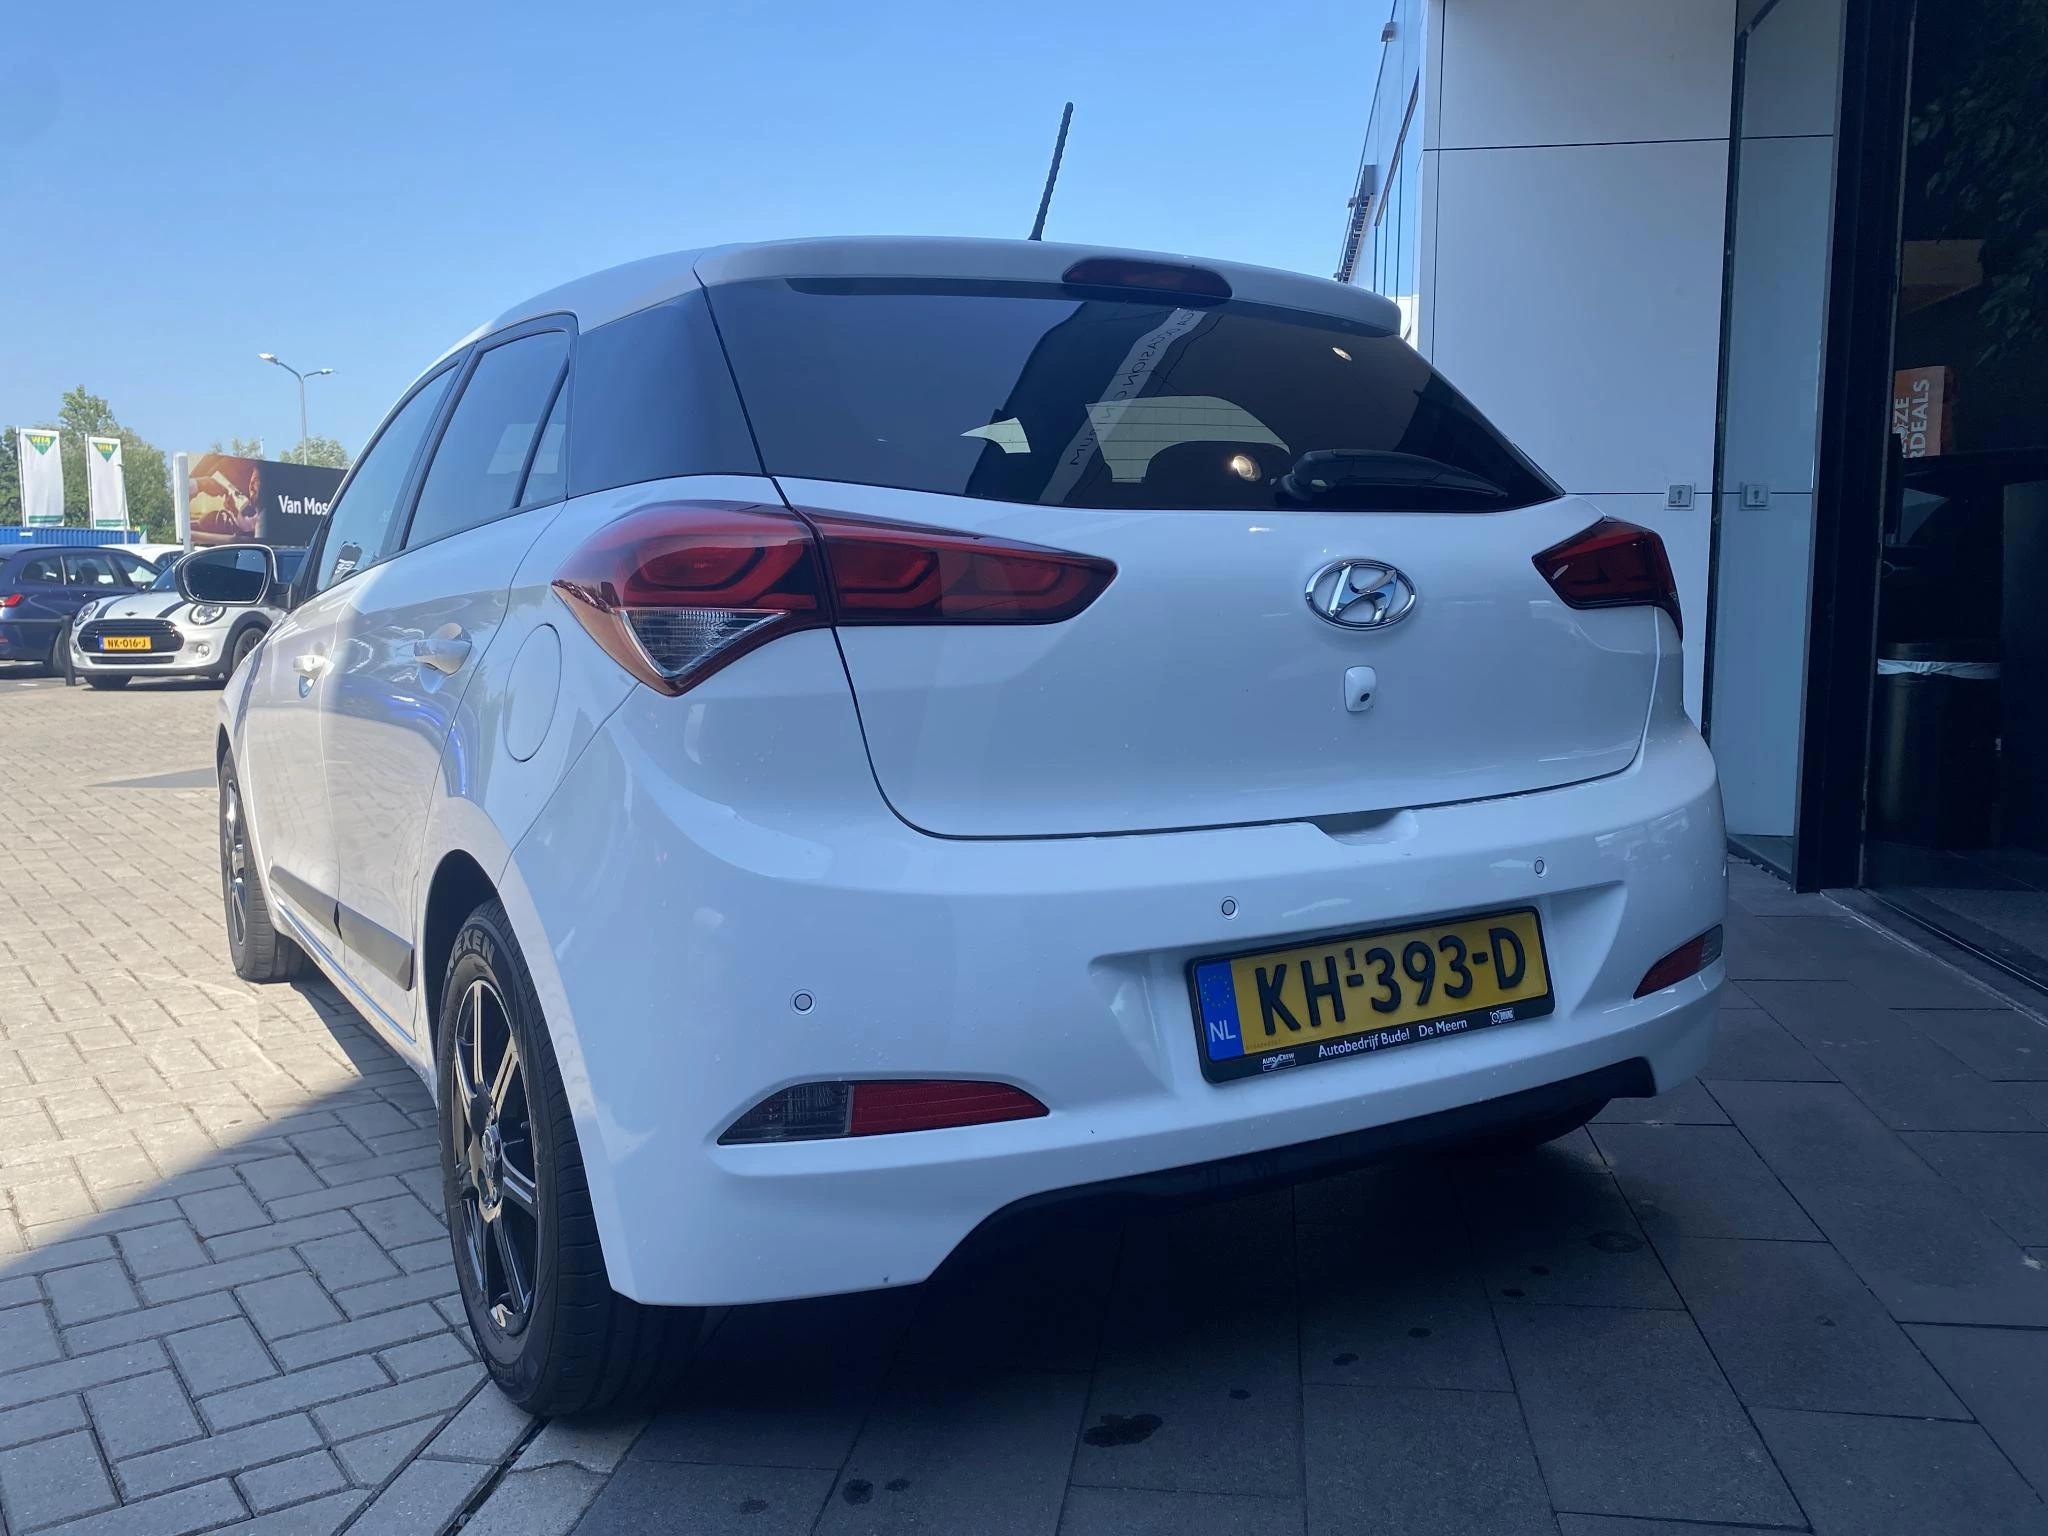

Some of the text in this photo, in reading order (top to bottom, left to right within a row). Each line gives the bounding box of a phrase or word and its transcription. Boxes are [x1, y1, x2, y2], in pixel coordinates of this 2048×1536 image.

[278, 494, 301, 514] Van
[107, 638, 146, 649] NK-016-J
[1255, 927, 1527, 1036] KH-393-D
[1210, 1019, 1236, 1043] NL
[1318, 1018, 1468, 1058] Autobedrijf Budel De Meern
